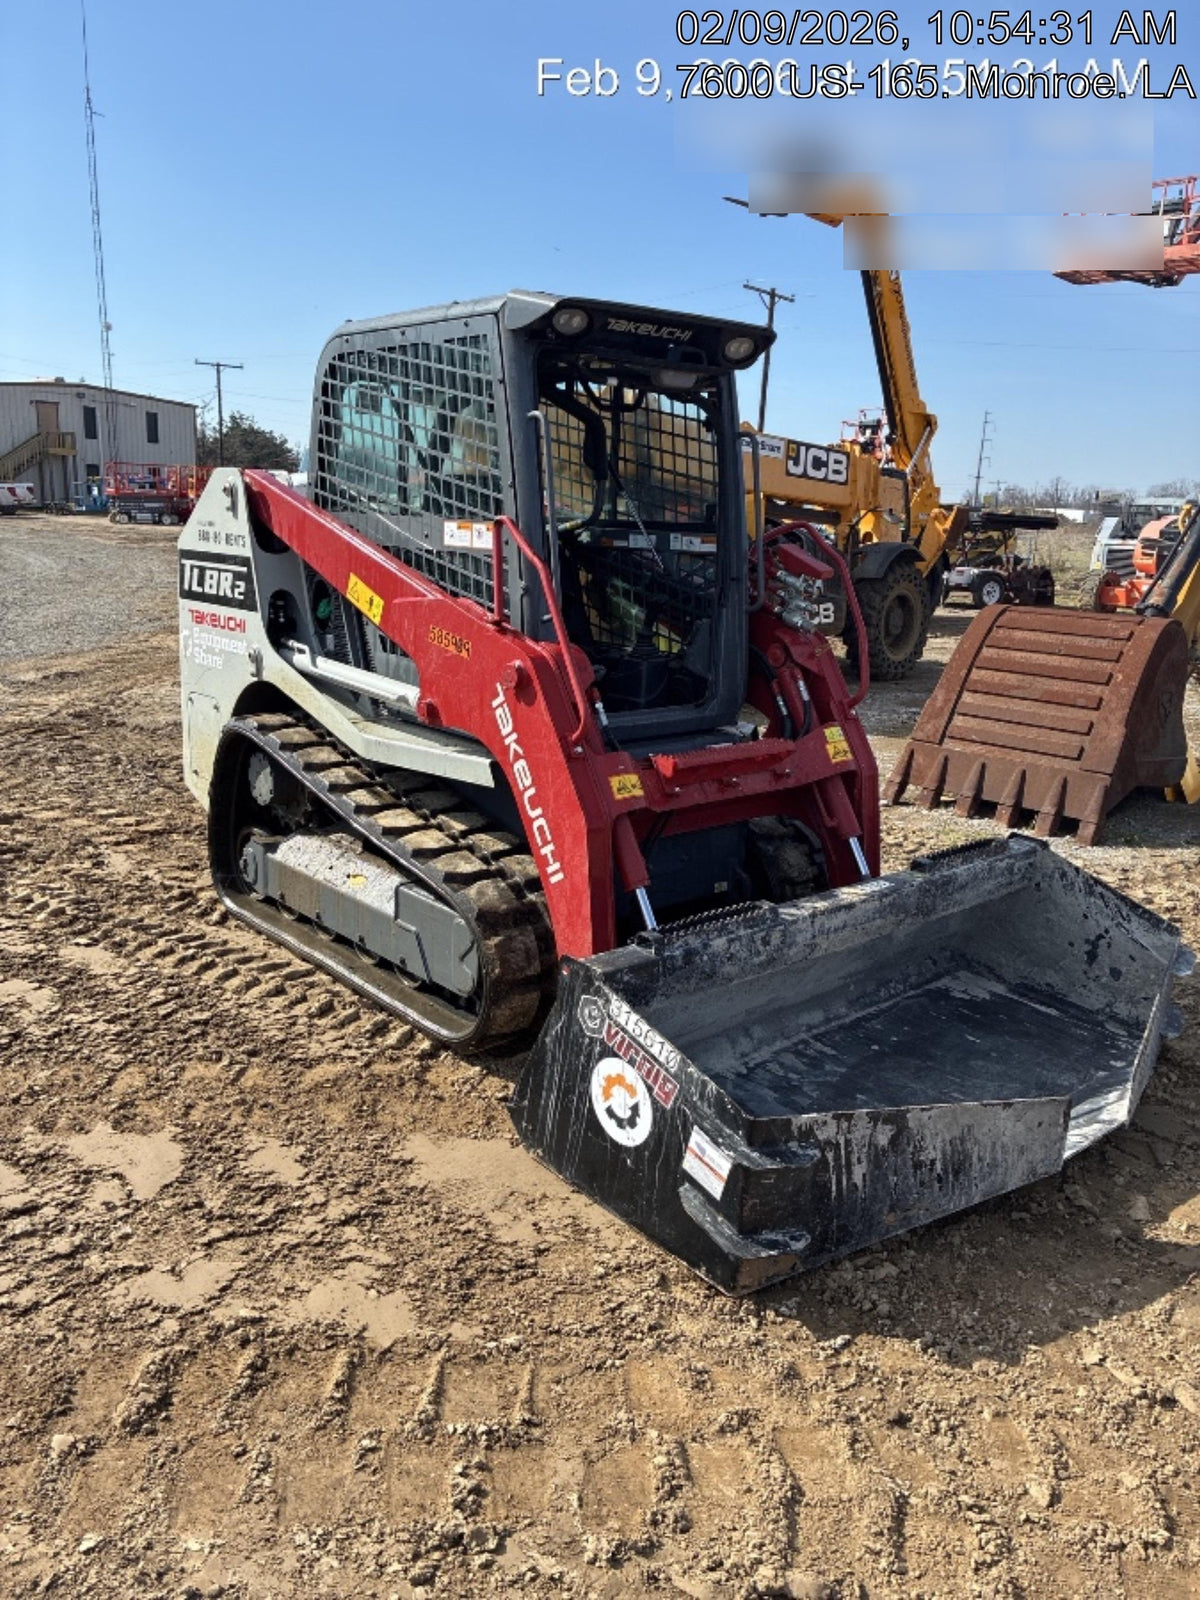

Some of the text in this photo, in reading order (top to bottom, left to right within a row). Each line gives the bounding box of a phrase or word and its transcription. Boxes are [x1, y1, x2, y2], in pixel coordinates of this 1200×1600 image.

[607, 318, 692, 341] TAKEUCHI
[787, 445, 847, 483] JCB
[181, 559, 248, 600] TL8R2
[188, 608, 246, 634] TAKEUCHI
[192, 627, 248, 655] Equipment
[193, 646, 223, 669] Share
[491, 682, 564, 884] TAKEUCHI
